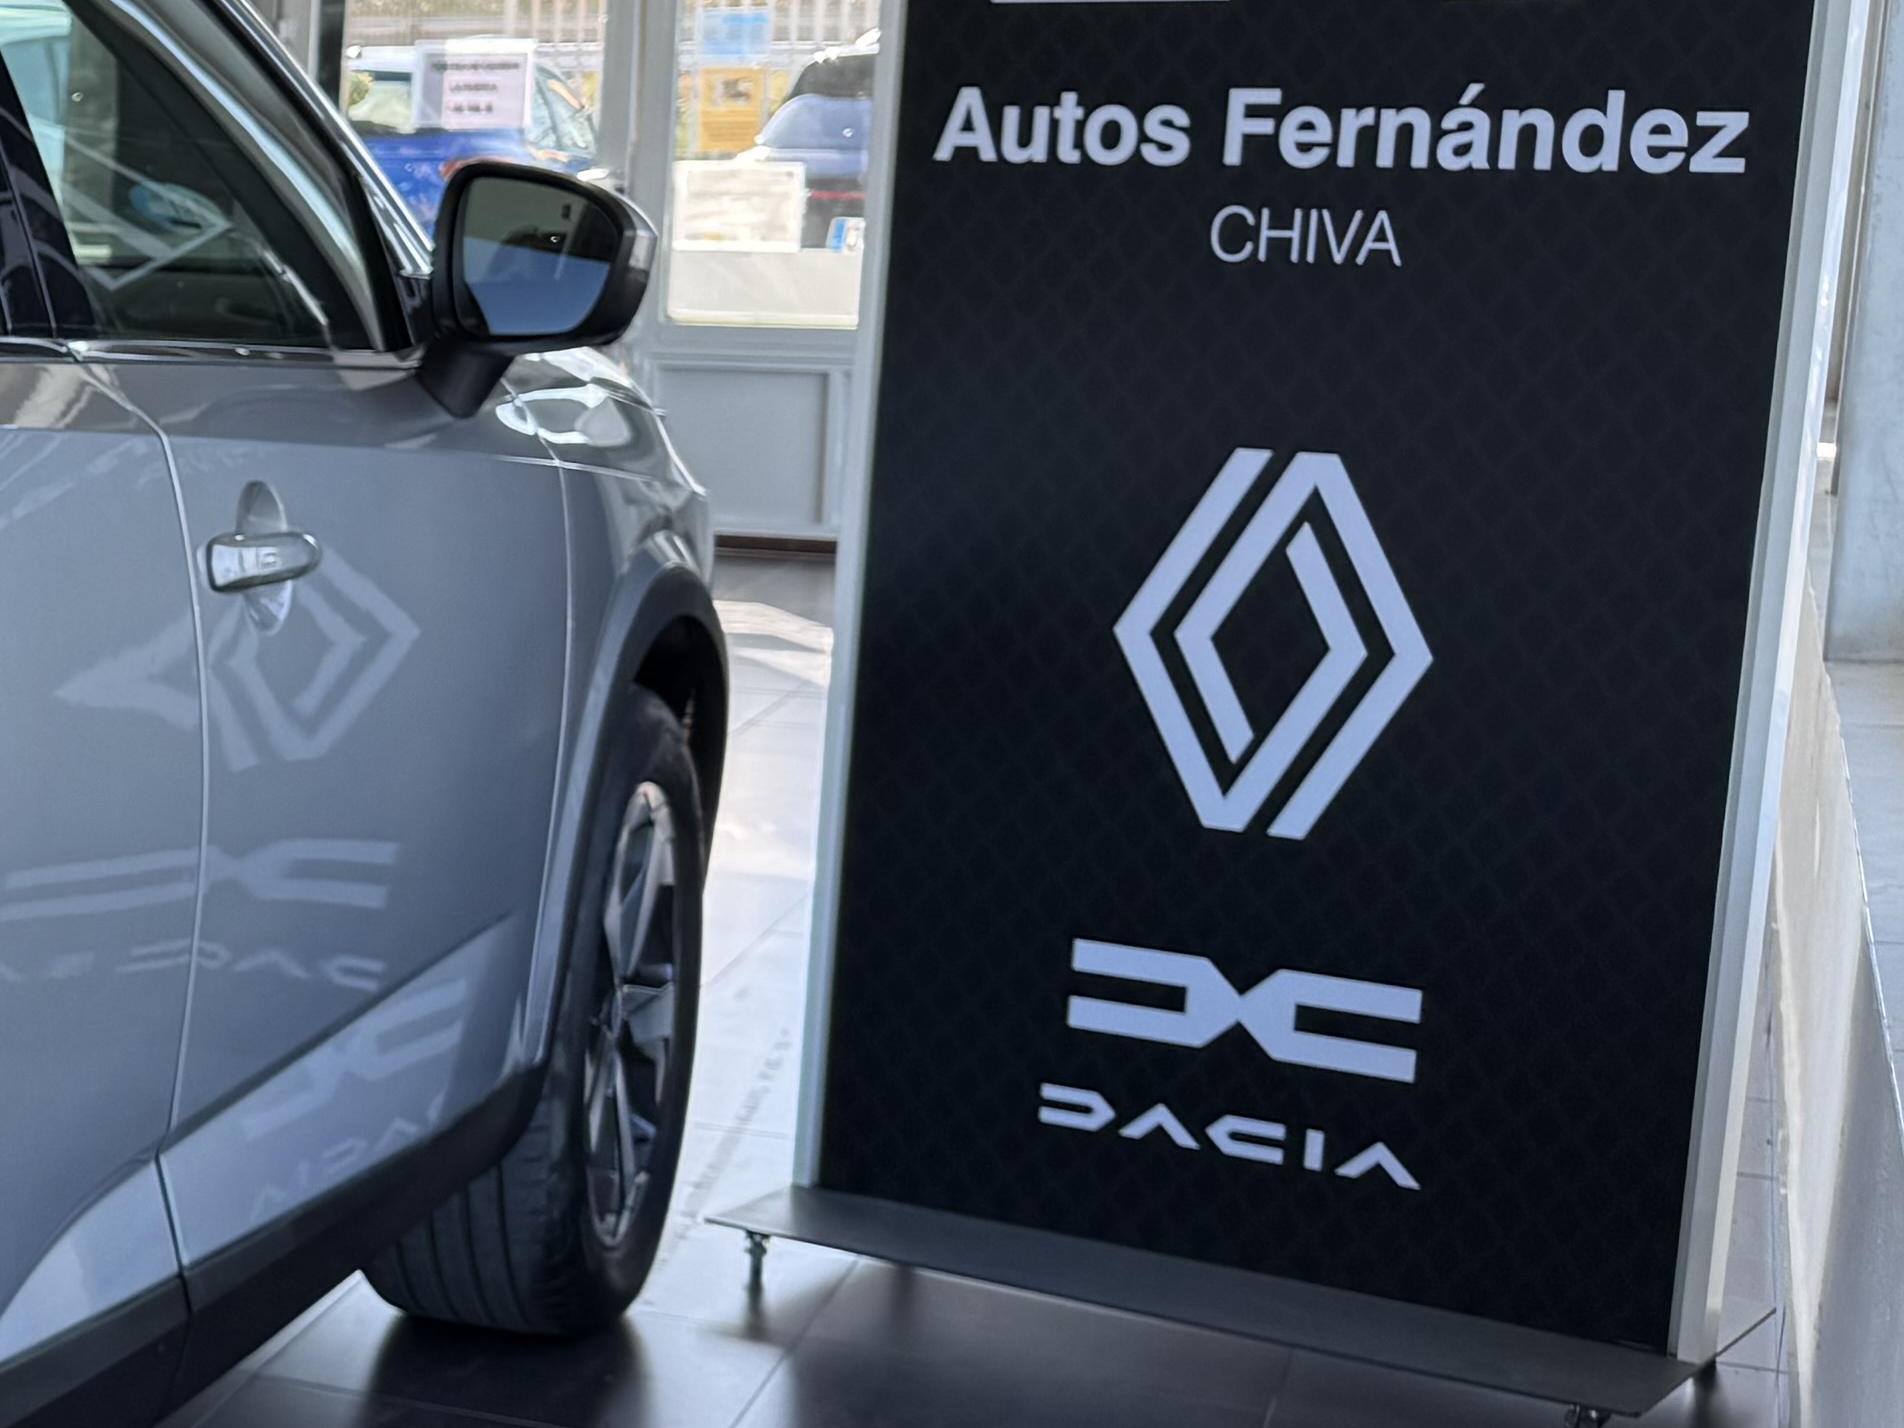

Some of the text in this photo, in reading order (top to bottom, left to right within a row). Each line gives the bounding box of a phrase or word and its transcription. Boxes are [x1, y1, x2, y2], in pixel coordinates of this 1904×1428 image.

[933, 82, 1751, 174] Autos Fernández
[1209, 204, 1403, 267] CHIVA
[1038, 1082, 1421, 1190] DACIA
